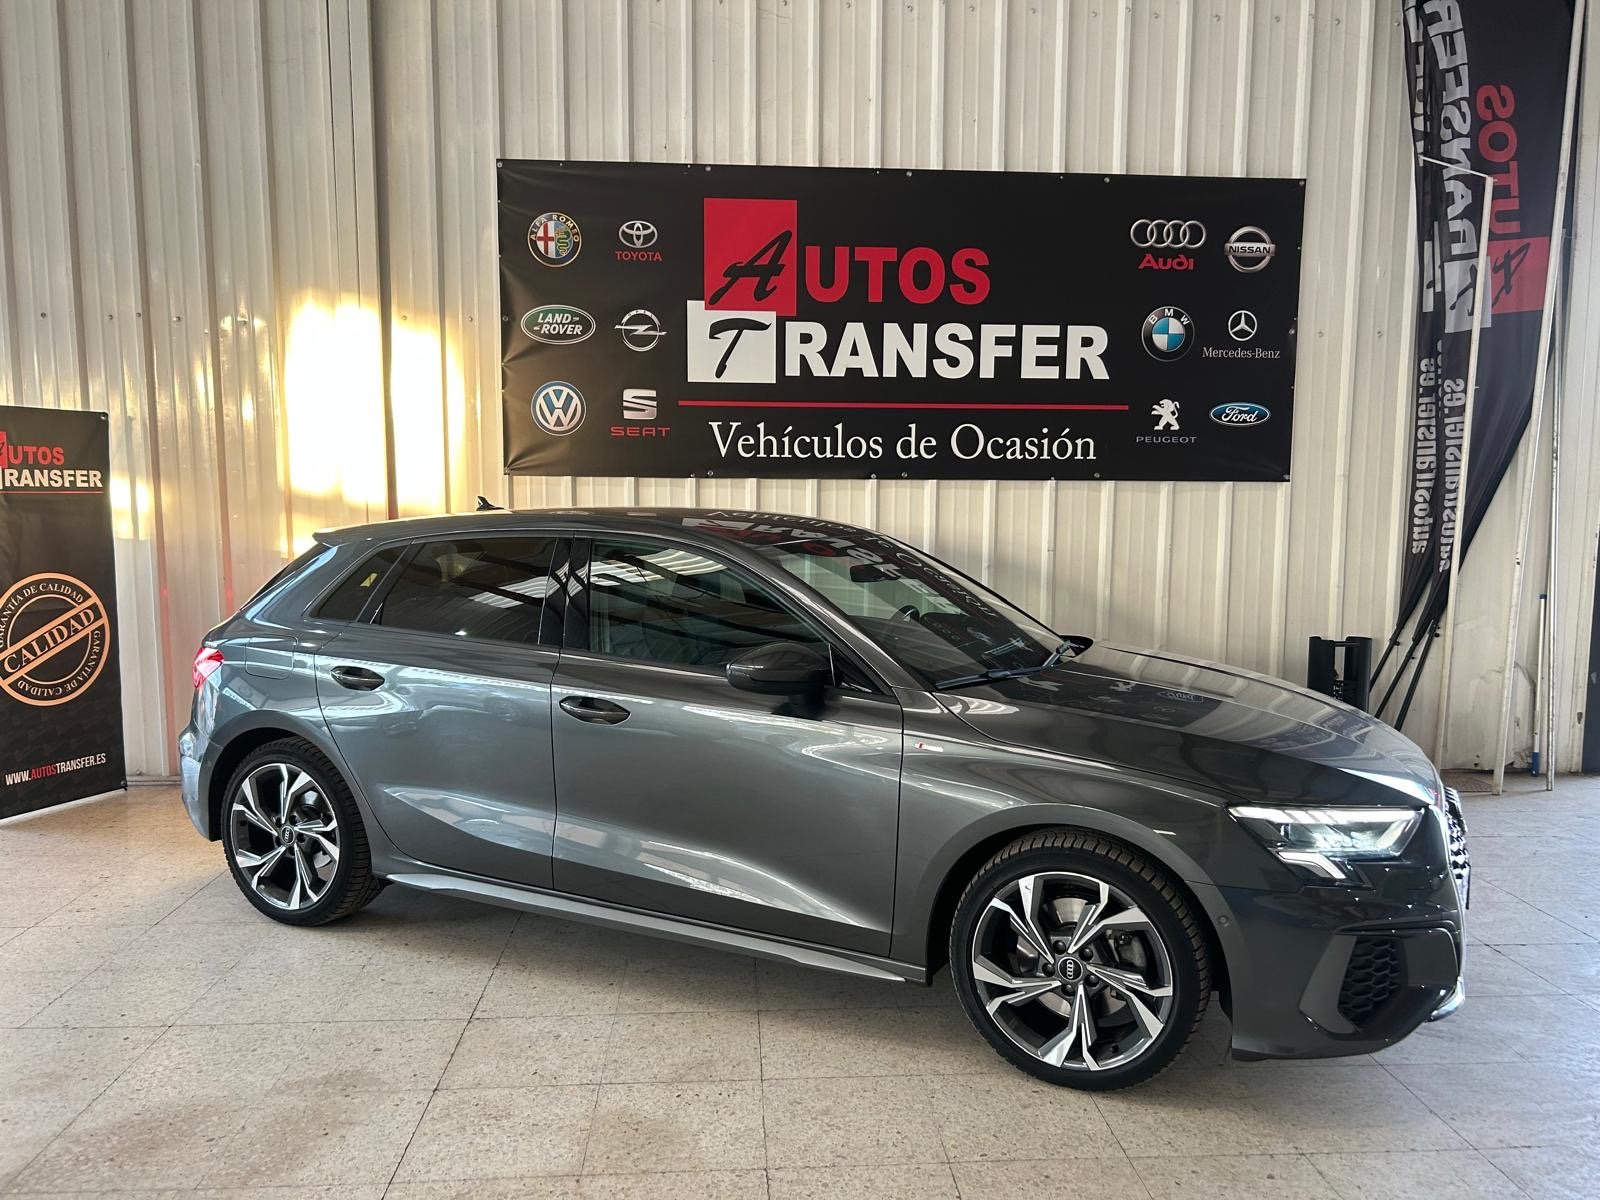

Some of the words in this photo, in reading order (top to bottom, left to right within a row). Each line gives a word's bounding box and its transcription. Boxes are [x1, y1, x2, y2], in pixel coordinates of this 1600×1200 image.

[529, 217, 548, 241] ALFA
[552, 214, 580, 242] ROMEO
[615, 251, 662, 262] TOYOTA
[1229, 245, 1271, 254] NISSAN
[708, 230, 991, 306] AUTOS
[1138, 253, 1195, 271] Audi
[1148, 308, 1190, 326] BMW
[708, 317, 1110, 380] TRANSFER
[1202, 346, 1281, 359] Mercedes-Benz
[1221, 405, 1258, 423] Ford
[610, 426, 671, 437] SEAT
[708, 420, 884, 459] Vehículos
[895, 423, 938, 460] de
[950, 422, 1097, 460] Ocasión
[1136, 436, 1197, 444] PEUGEOT
[0, 441, 65, 465] UTOS
[3, 468, 103, 488] RANSFER
[23, 586, 38, 597] DE
[39, 583, 84, 603] CALIDAD
[3, 608, 95, 673] CALIDAD
[17, 680, 63, 697] CALIDAD
[65, 681, 78, 692] DE
[5, 752, 107, 786] WWW.AUTOSTRANSFER.ES
